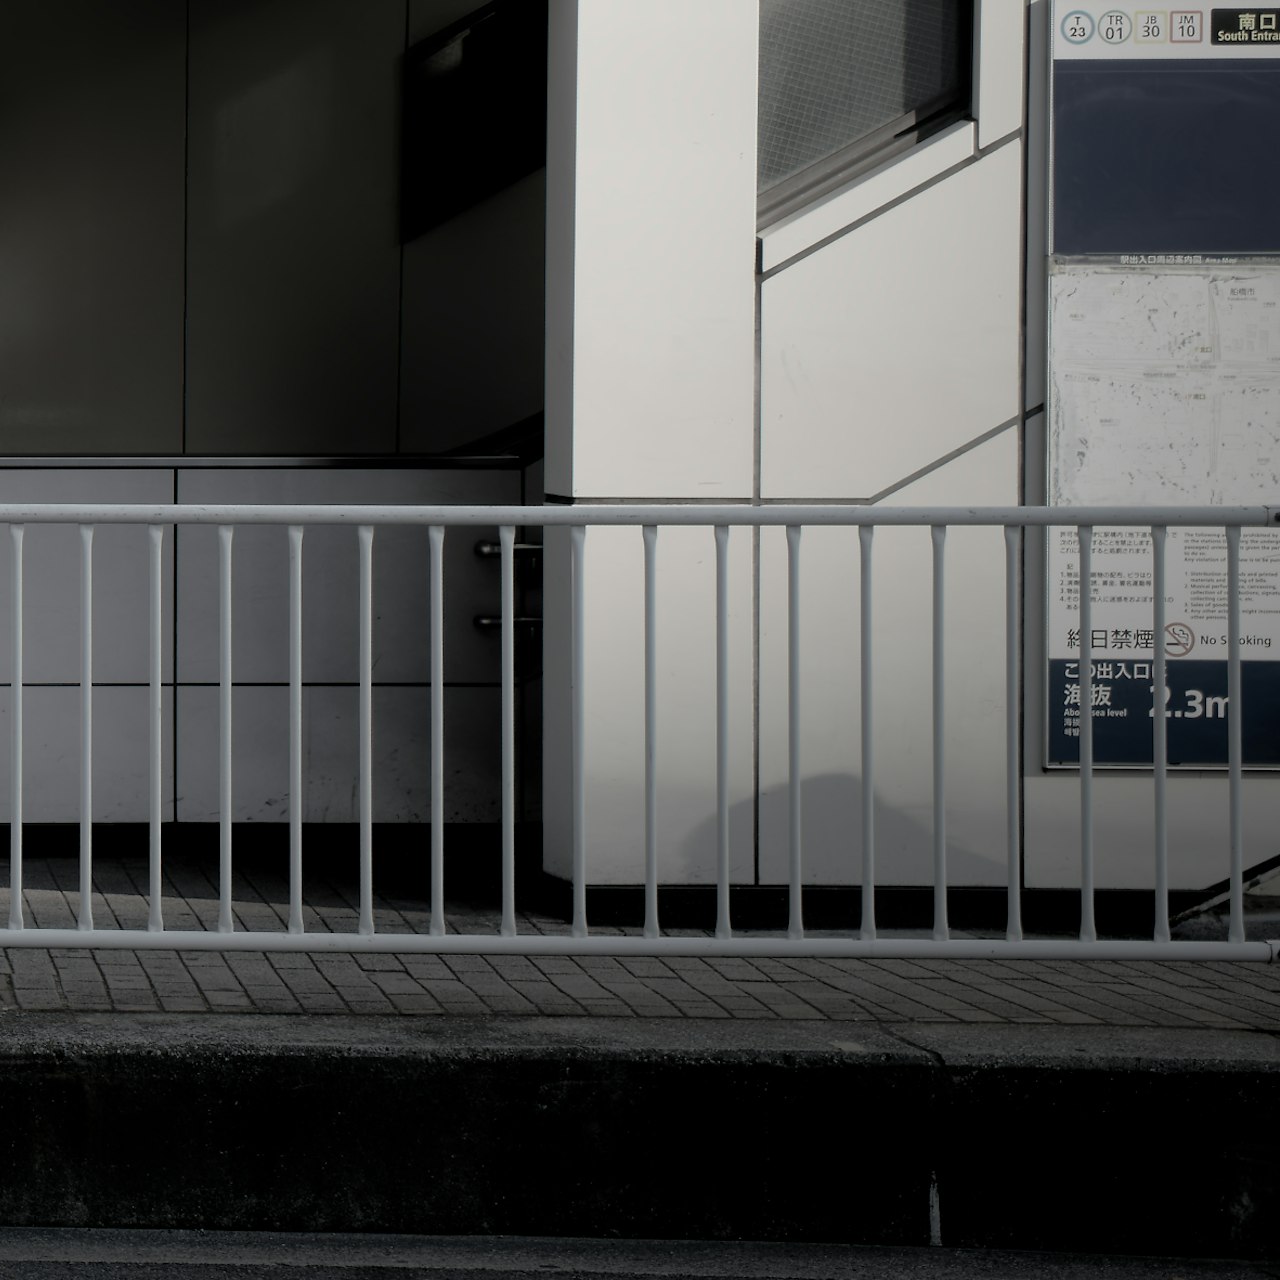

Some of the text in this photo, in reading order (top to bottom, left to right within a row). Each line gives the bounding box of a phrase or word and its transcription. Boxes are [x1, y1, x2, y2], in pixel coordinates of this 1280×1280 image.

[1074, 16, 1081, 25] T
[1107, 15, 1123, 25] TR
[1145, 15, 1157, 24] JB
[1179, 15, 1194, 24] JM
[1238, 13, 1276, 30] 南口
[1069, 27, 1086, 38] 23
[1105, 27, 1123, 40] 01
[1142, 26, 1160, 37] 30
[1178, 26, 1195, 37] 10
[1217, 30, 1249, 41] South
[1067, 628, 1154, 649] 終日禁煙
[1200, 635, 1272, 648] No Soking
[1091, 709, 1106, 717] sea
[1107, 708, 1127, 717] level
